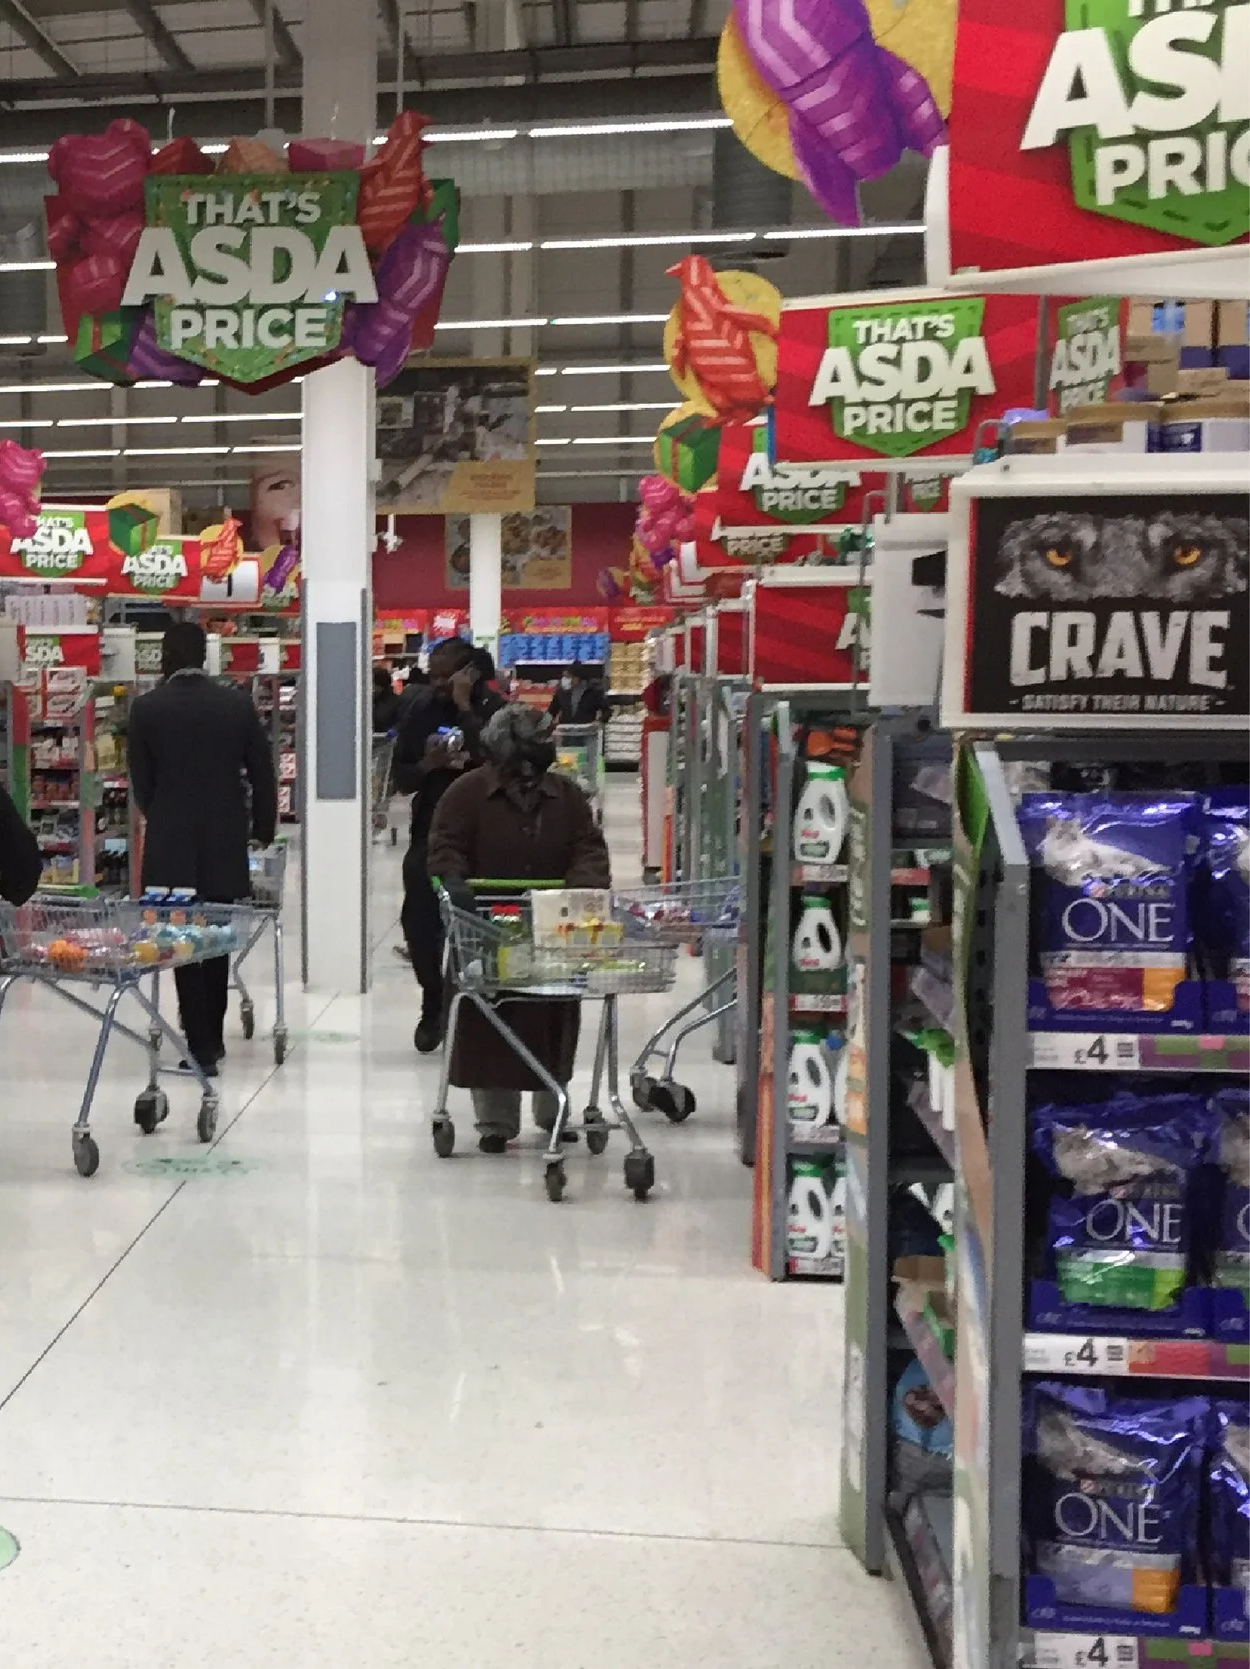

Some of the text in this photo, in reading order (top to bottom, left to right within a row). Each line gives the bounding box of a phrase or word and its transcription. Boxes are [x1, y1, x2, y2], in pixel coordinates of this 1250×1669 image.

[180, 192, 322, 225] THAT'S
[120, 225, 379, 306] ASDA
[170, 307, 327, 350] PRICE
[852, 312, 955, 344] THAT'S
[809, 337, 996, 407] ASDA
[1050, 325, 1121, 390] ASDA
[843, 399, 960, 437] PRICE
[761, 488, 839, 512] PRICE
[26, 553, 78, 568] PRICE
[120, 555, 189, 577] ASDA
[1010, 610, 1231, 689] CRAVE
[1022, 695, 1211, 711] SATISFY THEIR NATURE
[1062, 898, 1177, 942] ONE
[1074, 1035, 1109, 1064] £4
[1086, 1198, 1186, 1243] ONE
[1064, 1338, 1098, 1367] £4
[1055, 1493, 1164, 1543] ONE
[1074, 1637, 1109, 1667] £4
